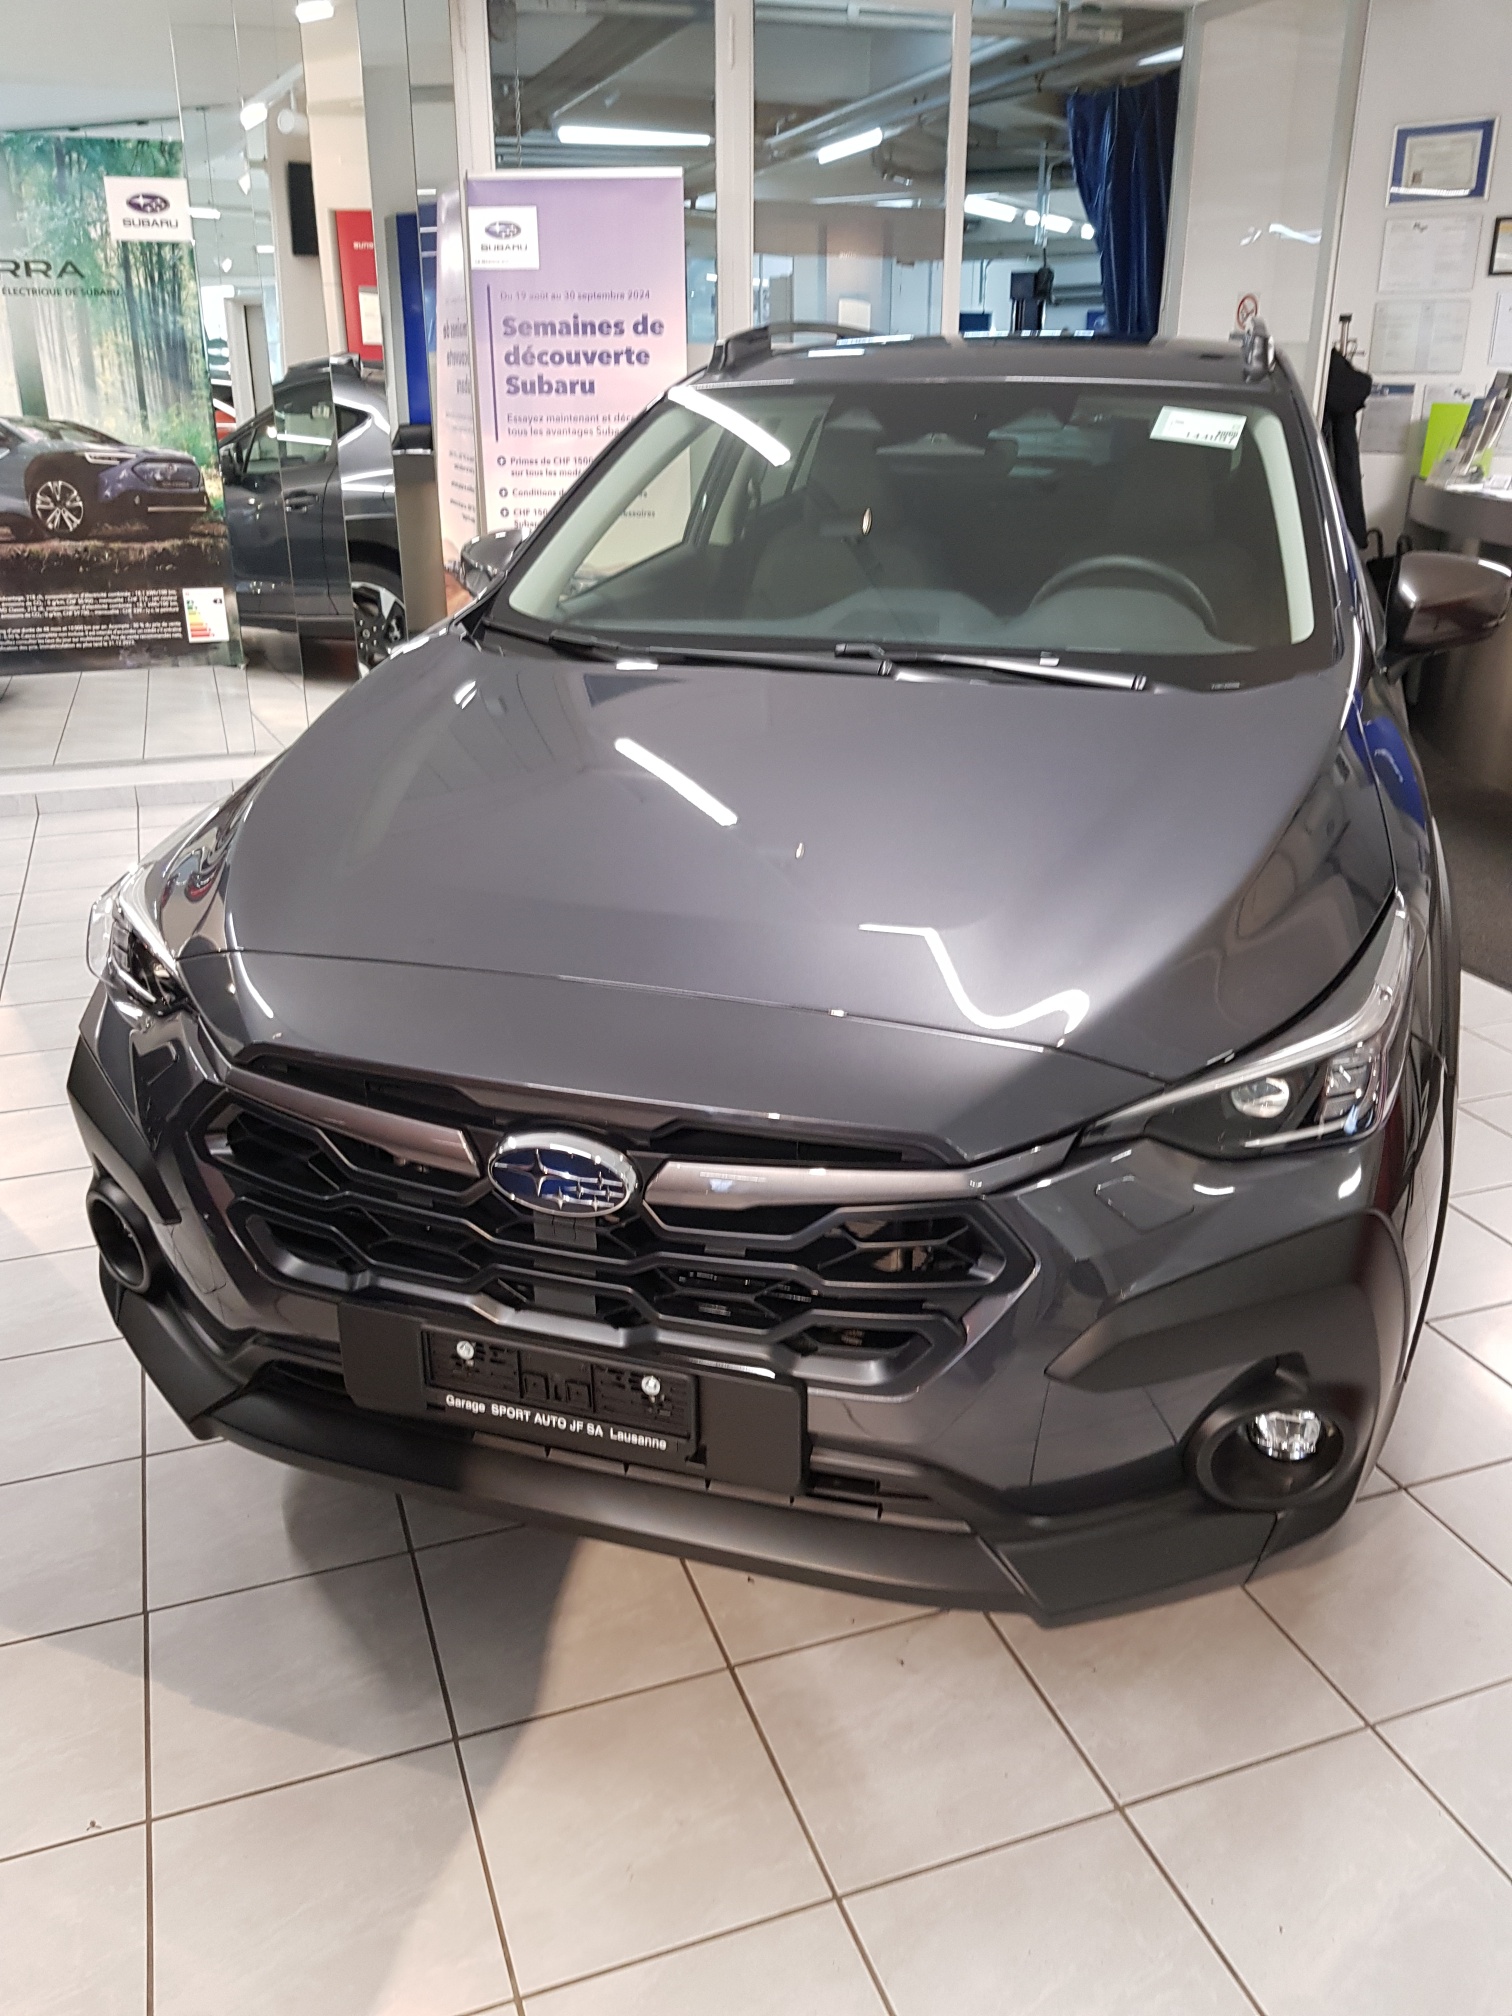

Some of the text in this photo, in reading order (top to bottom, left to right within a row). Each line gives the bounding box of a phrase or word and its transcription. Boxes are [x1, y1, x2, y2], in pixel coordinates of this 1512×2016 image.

[122, 217, 179, 229] SUBARU
[480, 243, 528, 252] SUBARU
[502, 312, 665, 337] Semaines de
[504, 344, 650, 366] découverte
[505, 372, 596, 395] Subaru
[507, 413, 543, 426] Essayez
[546, 413, 599, 423] maintenant
[602, 413, 611, 423] et
[507, 427, 528, 436] tous
[530, 426, 543, 436] les
[546, 427, 594, 438] avantages
[510, 456, 538, 465] Primes
[541, 456, 551, 465] de
[553, 456, 570, 465] CHF
[526, 469, 543, 477] tous
[545, 469, 557, 477] les
[512, 487, 556, 497] Conditions
[446, 1394, 667, 1451] Garage SPORT AUTO JF SA Lausanne
